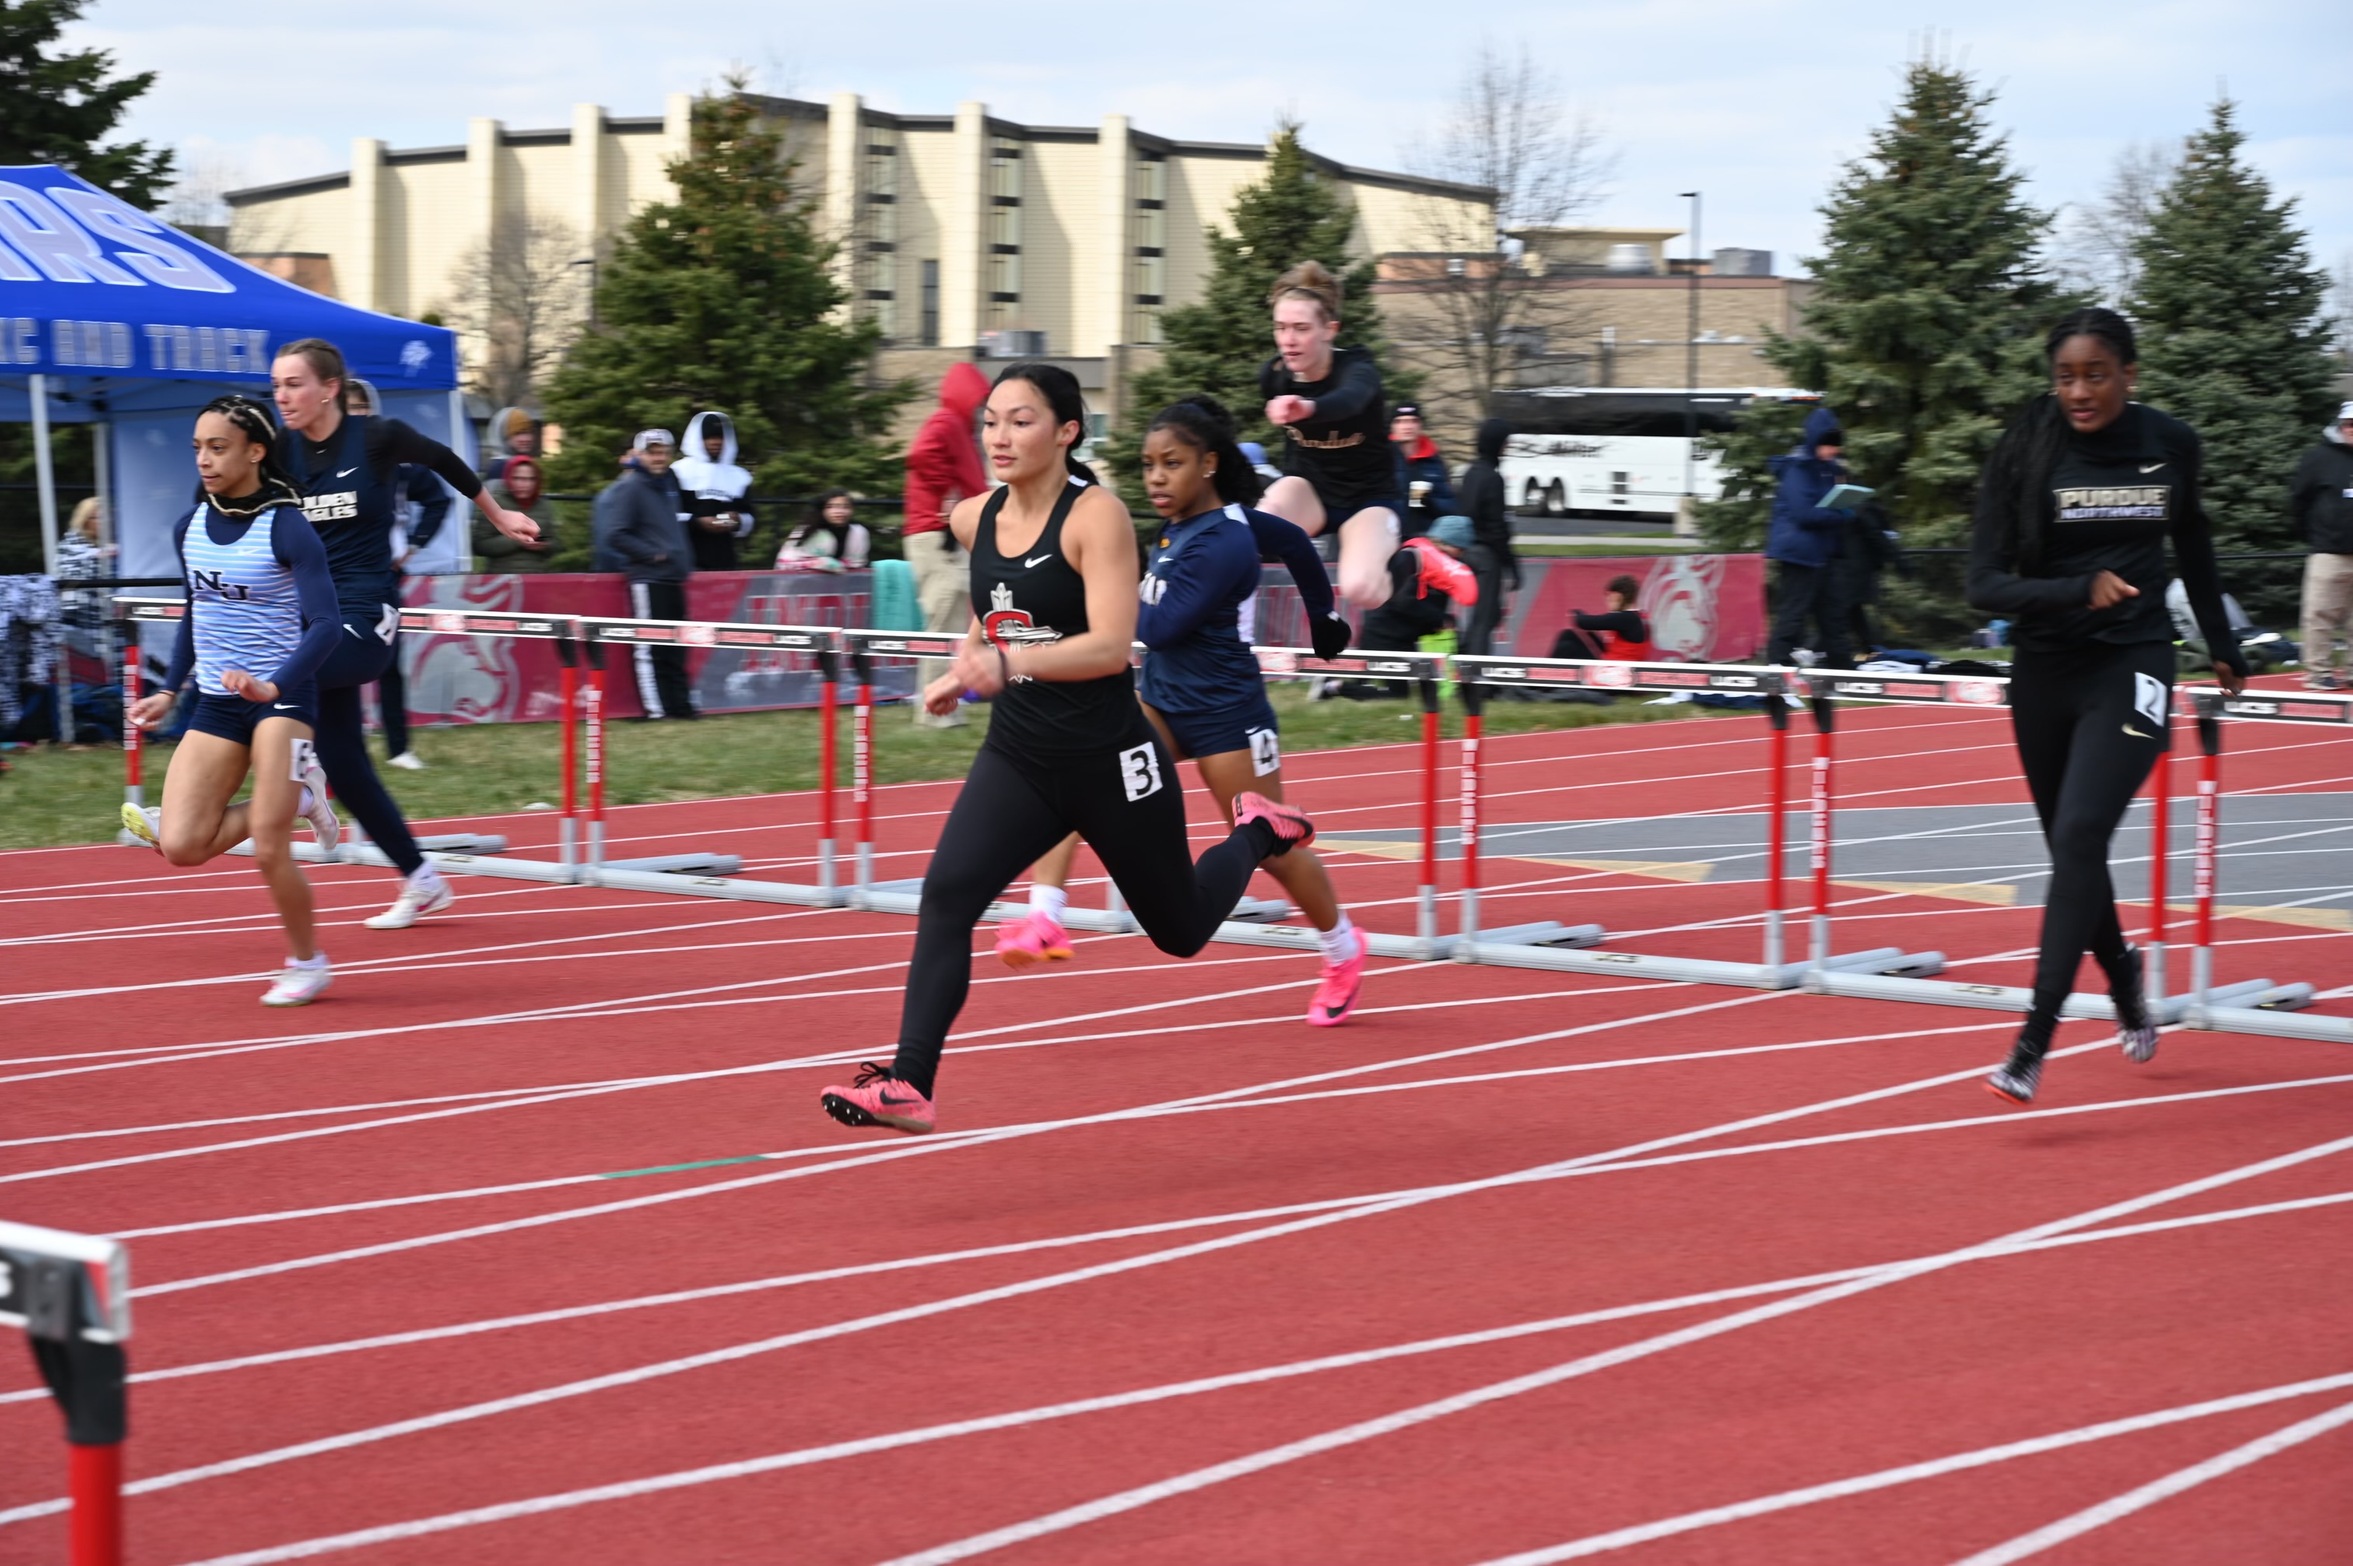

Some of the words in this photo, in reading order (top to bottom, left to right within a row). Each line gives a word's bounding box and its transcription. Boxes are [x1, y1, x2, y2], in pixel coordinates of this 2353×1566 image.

[142, 324, 271, 374] TRACK
[2060, 488, 2167, 508] PURDUE
[193, 570, 249, 601] NU
[2144, 679, 2160, 718] 2
[1130, 750, 1154, 796] 3
